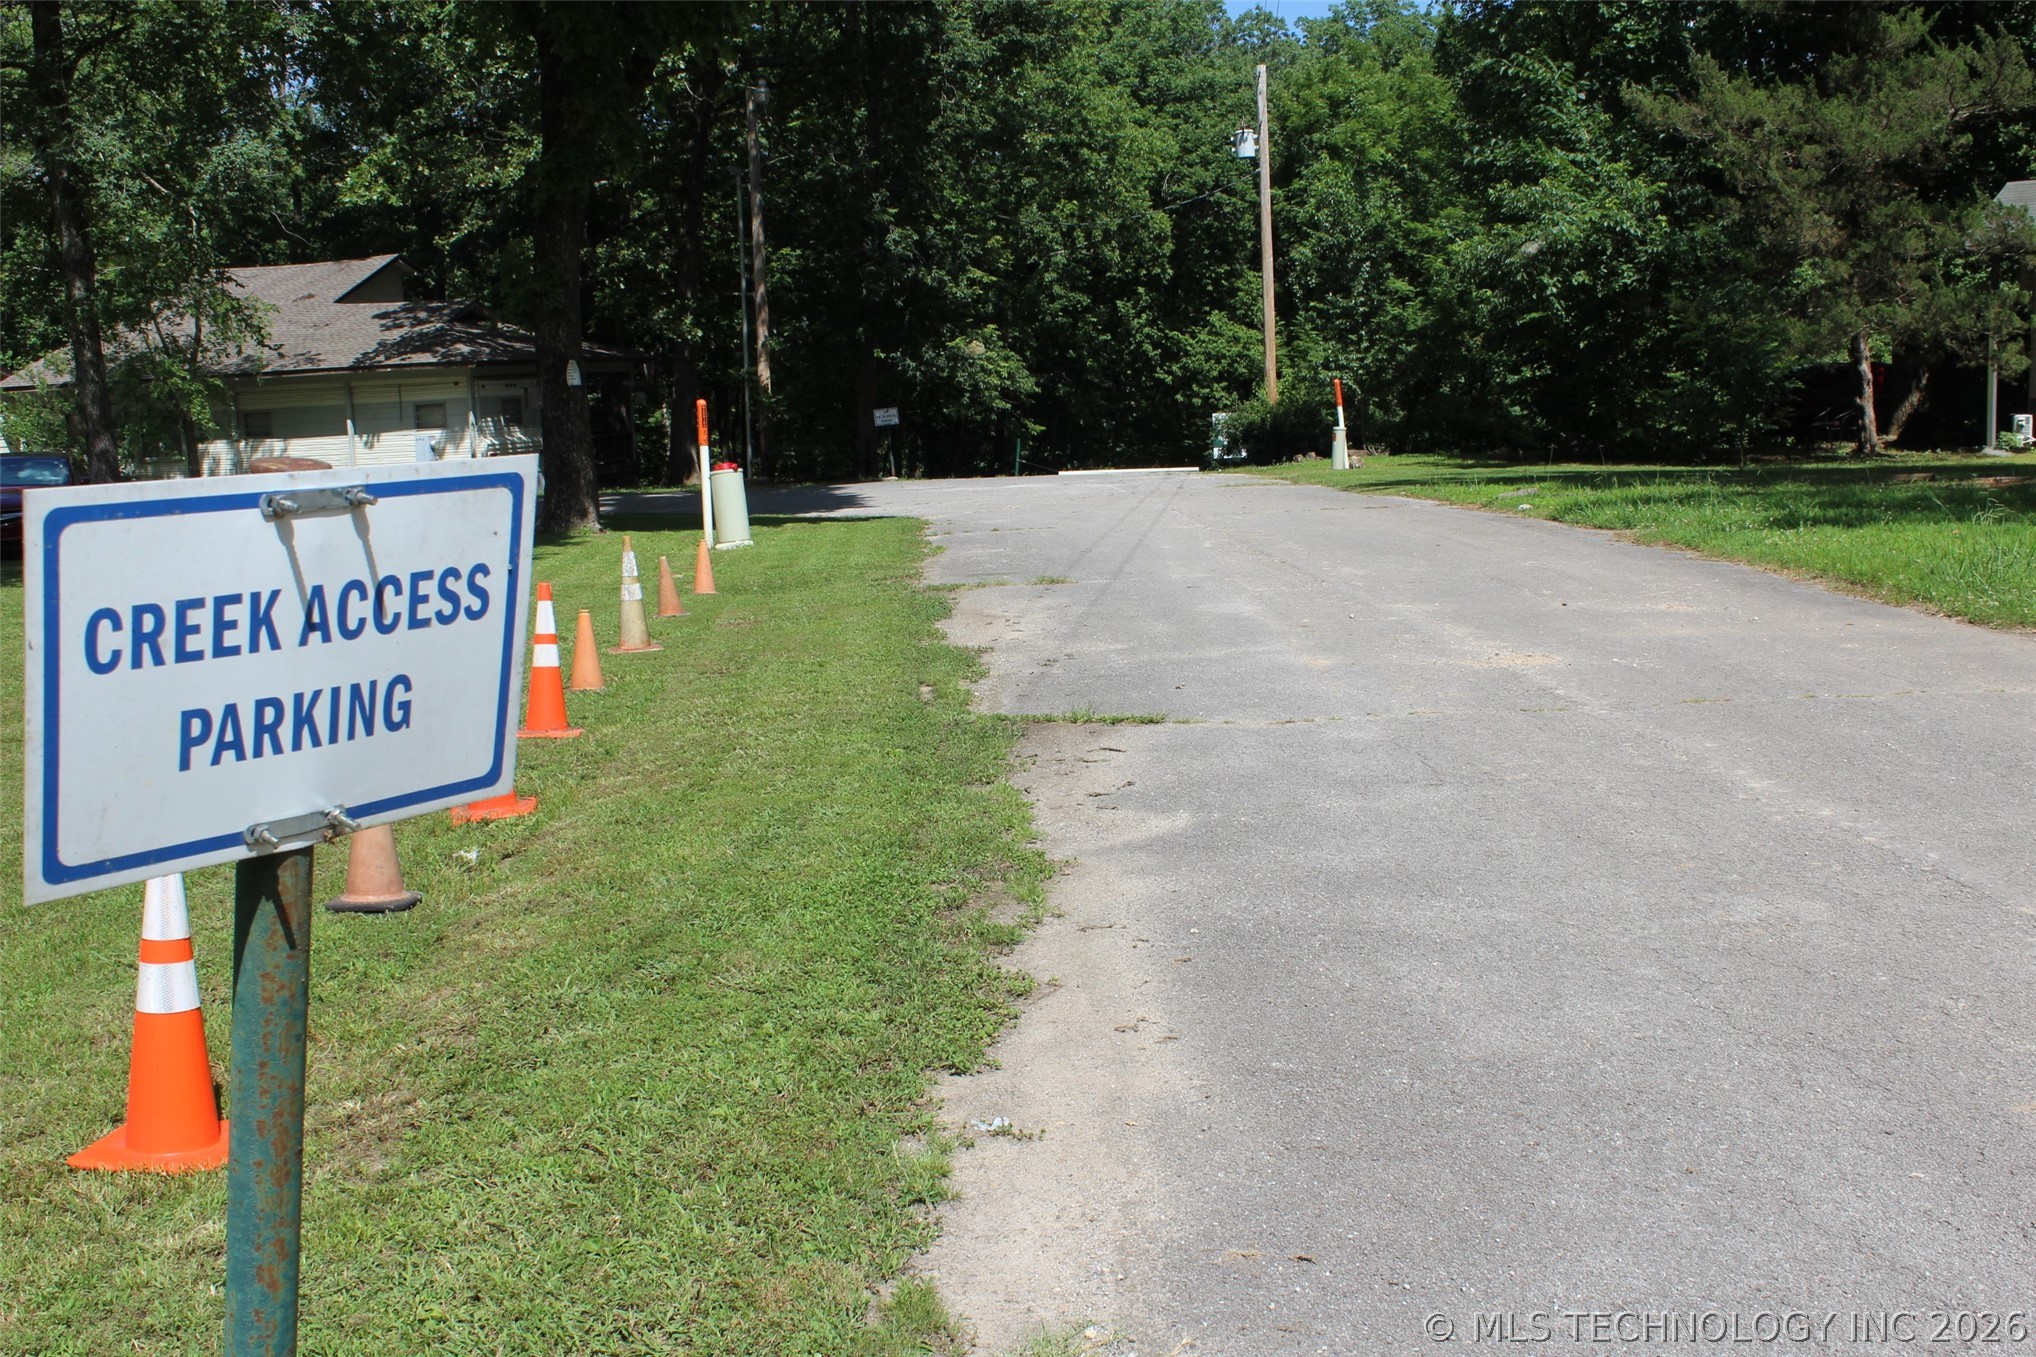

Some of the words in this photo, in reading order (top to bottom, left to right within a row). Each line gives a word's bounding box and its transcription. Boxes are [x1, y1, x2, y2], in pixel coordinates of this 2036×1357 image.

[84, 588, 282, 675] CREEK
[298, 562, 491, 647] ACCESS
[178, 673, 413, 772] PARKING
